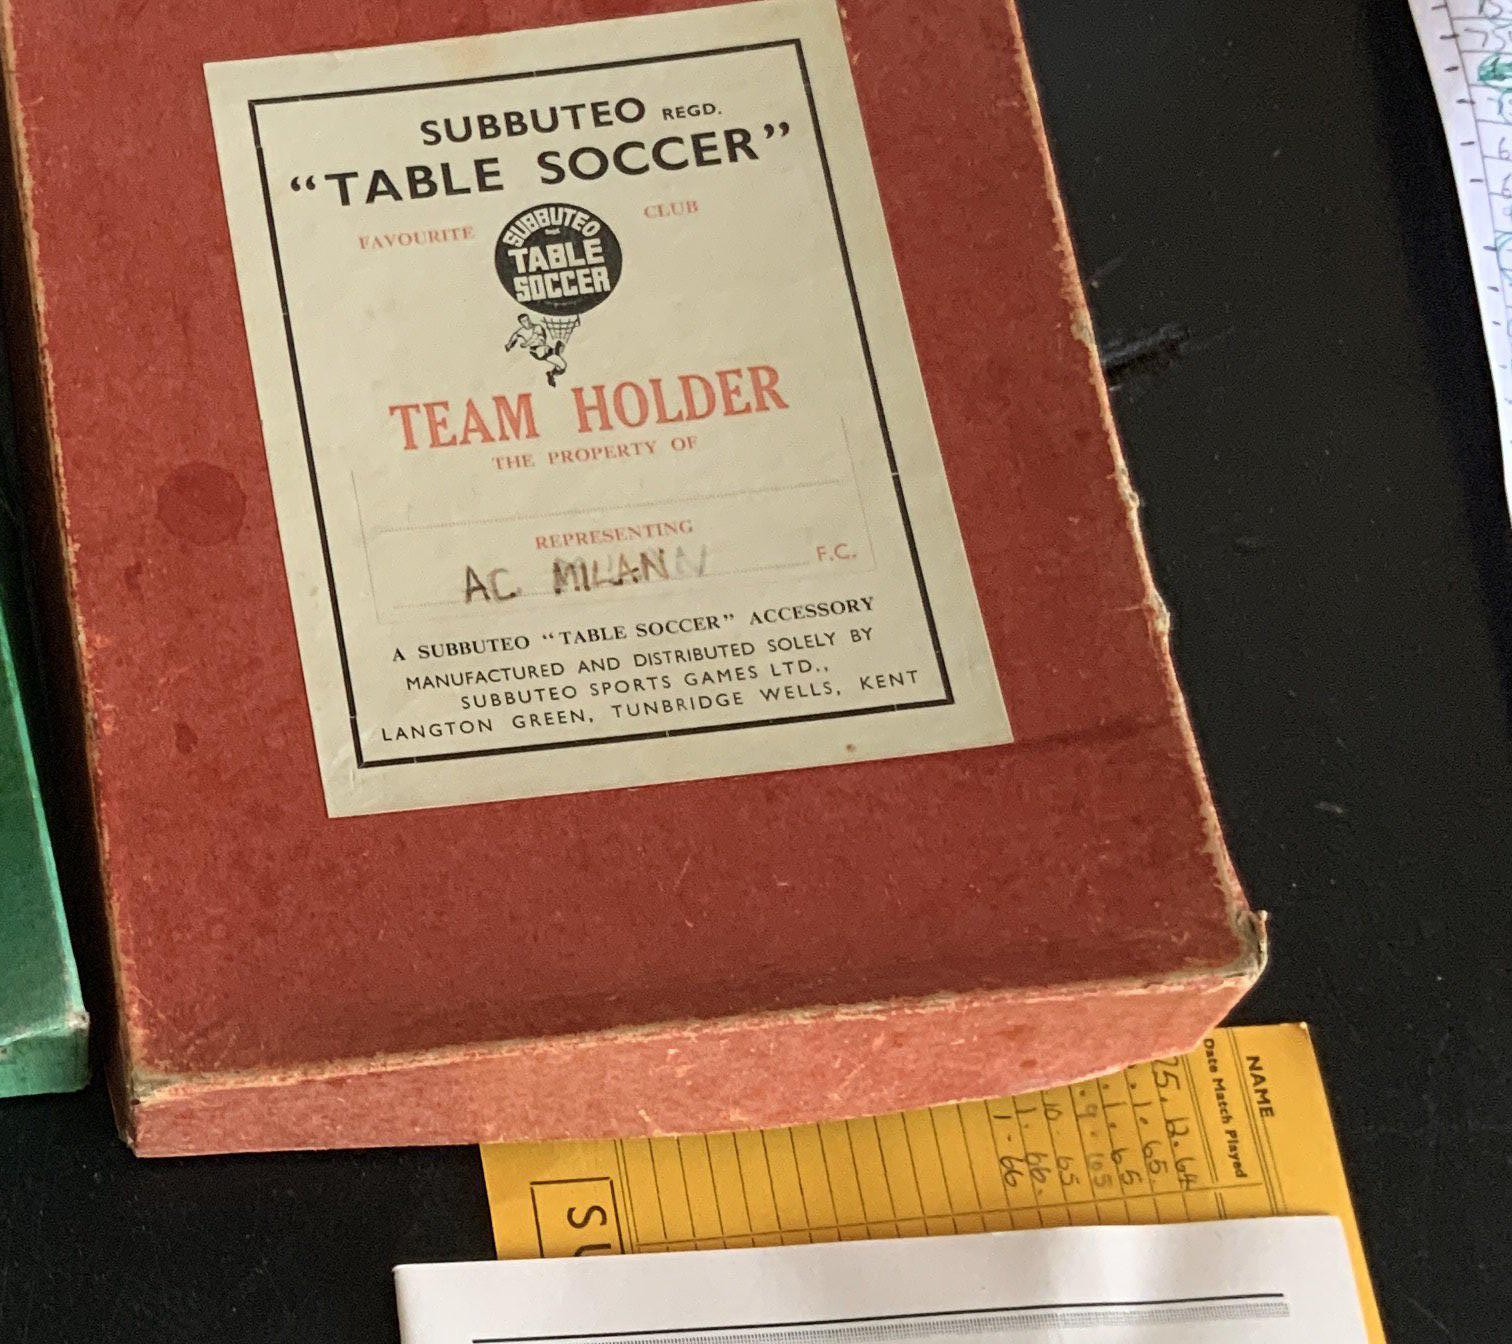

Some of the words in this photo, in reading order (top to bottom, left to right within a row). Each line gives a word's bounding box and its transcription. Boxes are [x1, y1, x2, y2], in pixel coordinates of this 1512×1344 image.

[420, 97, 645, 146] SUBBUTEO
[662, 103, 722, 120] REGD.
[291, 157, 504, 206] “TABLE
[537, 122, 789, 185] SOCCER”
[389, 392, 540, 451] TEAM
[577, 364, 789, 438] HOLDER
[1203, 1038, 1220, 1074] Date
[1211, 1077, 1233, 1124] Match
[1246, 1056, 1275, 1119] NAME
[1225, 1129, 1248, 1179] Played
